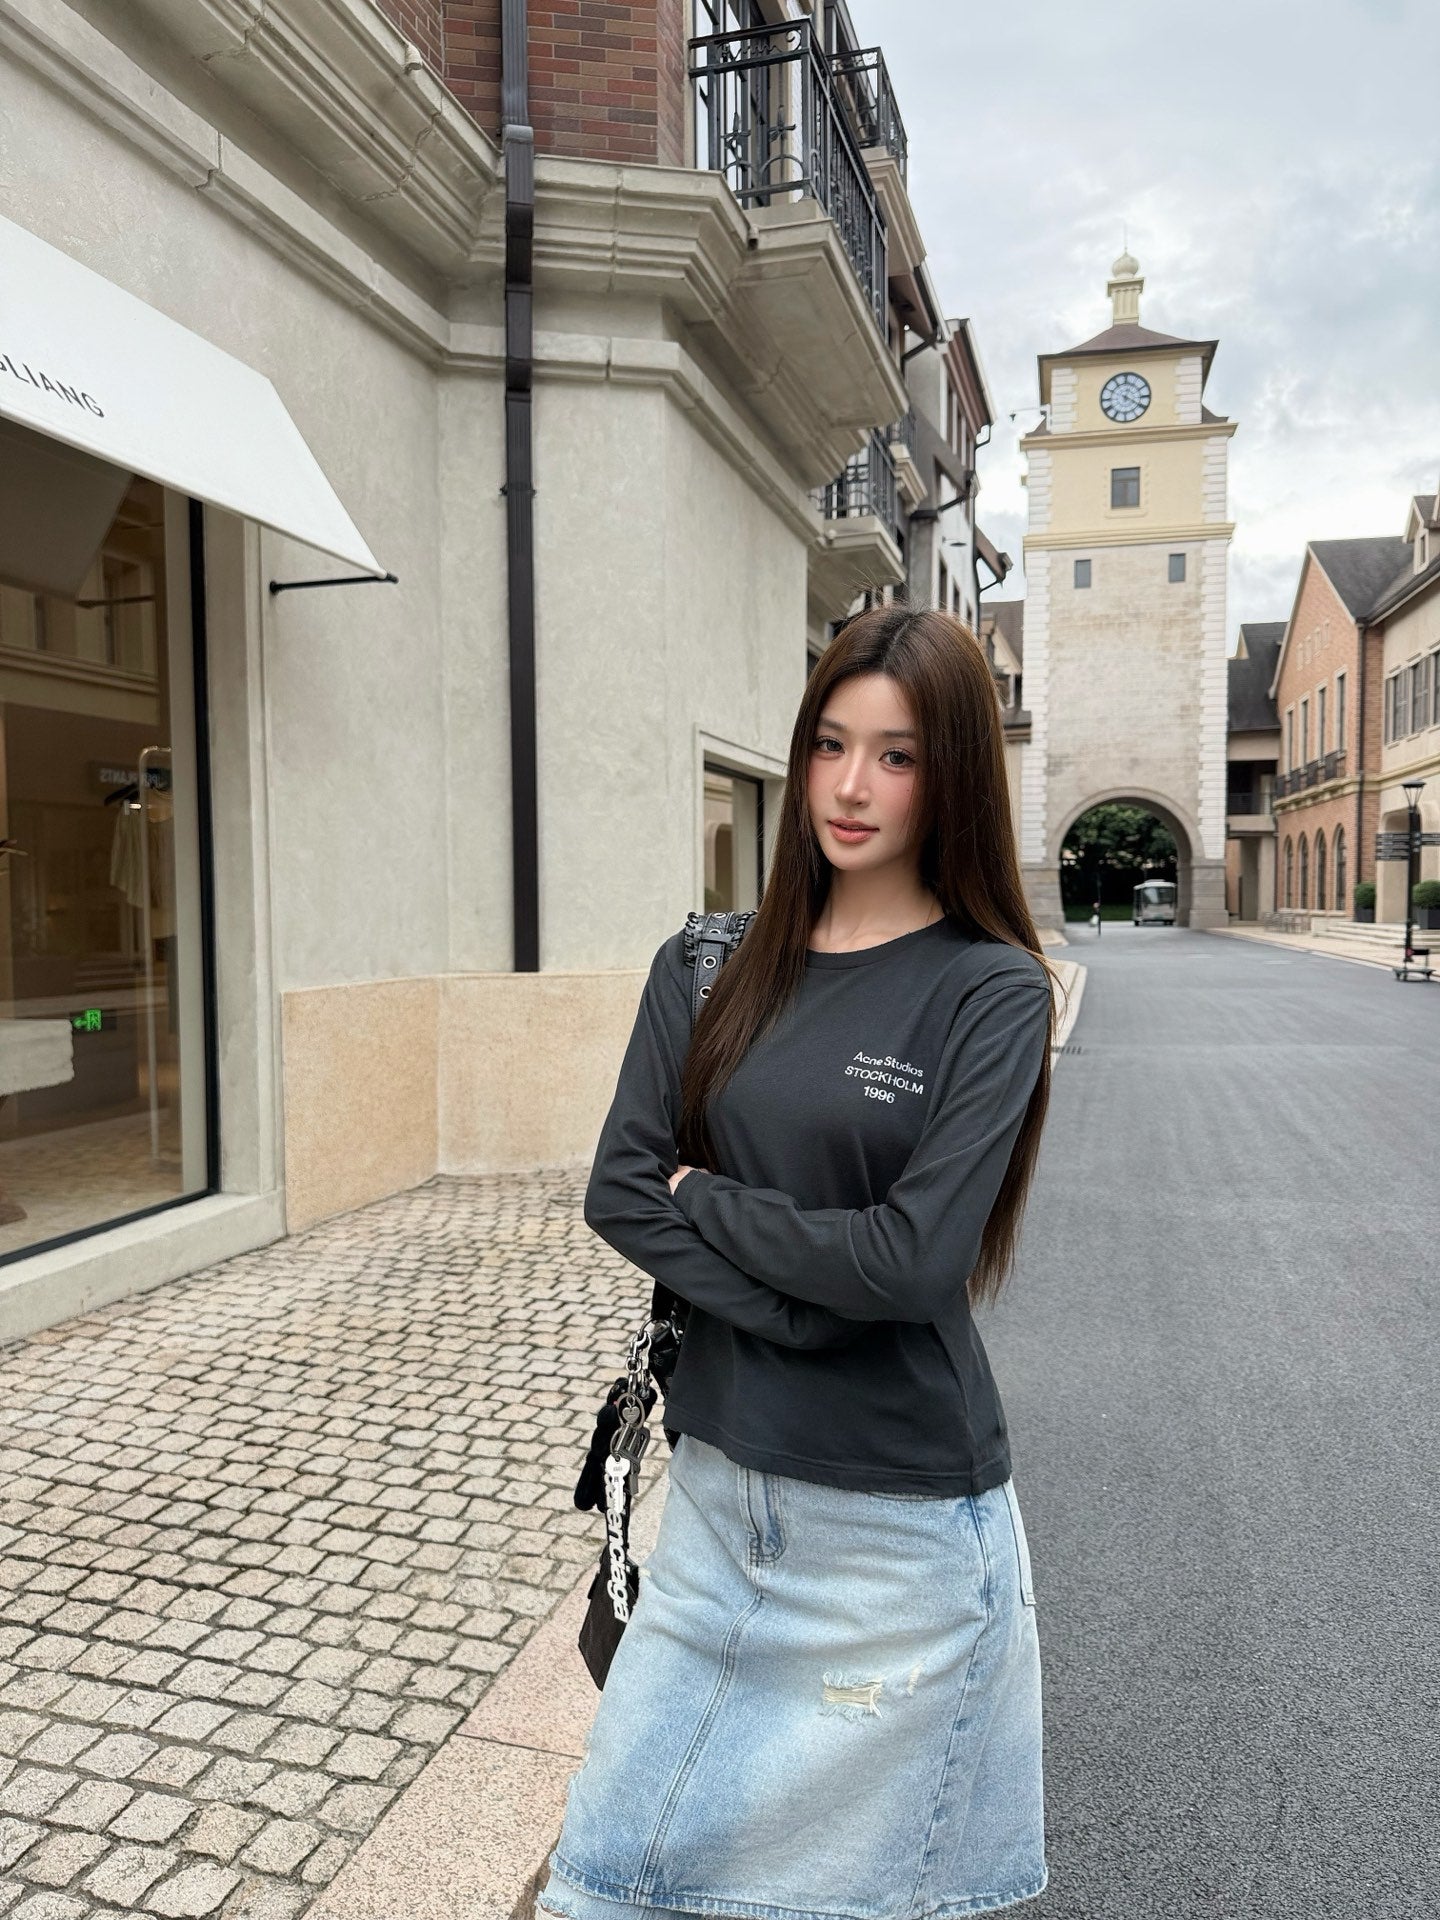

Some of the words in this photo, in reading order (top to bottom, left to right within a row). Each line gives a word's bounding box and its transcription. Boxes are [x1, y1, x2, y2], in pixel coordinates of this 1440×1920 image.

[853, 1051, 883, 1066] Acne
[883, 1055, 924, 1078] Studios
[844, 1065, 924, 1095] STOCKHOLM
[863, 1085, 896, 1104] 1996
